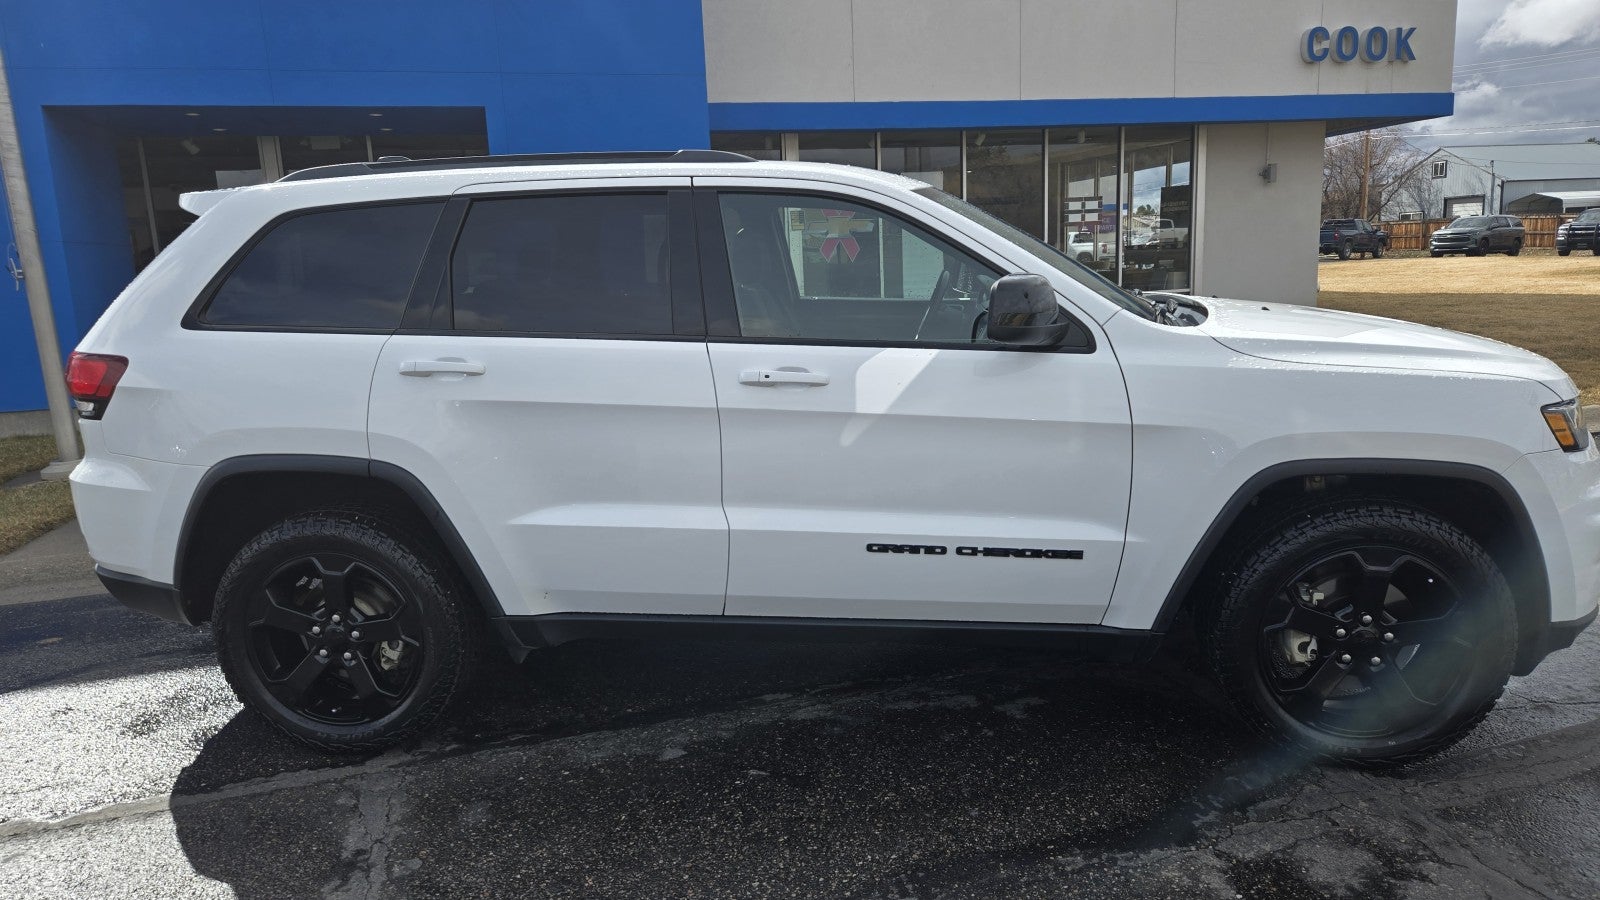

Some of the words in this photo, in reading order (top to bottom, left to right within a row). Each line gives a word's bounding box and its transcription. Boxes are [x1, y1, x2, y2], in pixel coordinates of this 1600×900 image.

[1305, 26, 1417, 62] COOK
[866, 543, 948, 555] GRAND
[956, 546, 1084, 560] CHEROKEE
